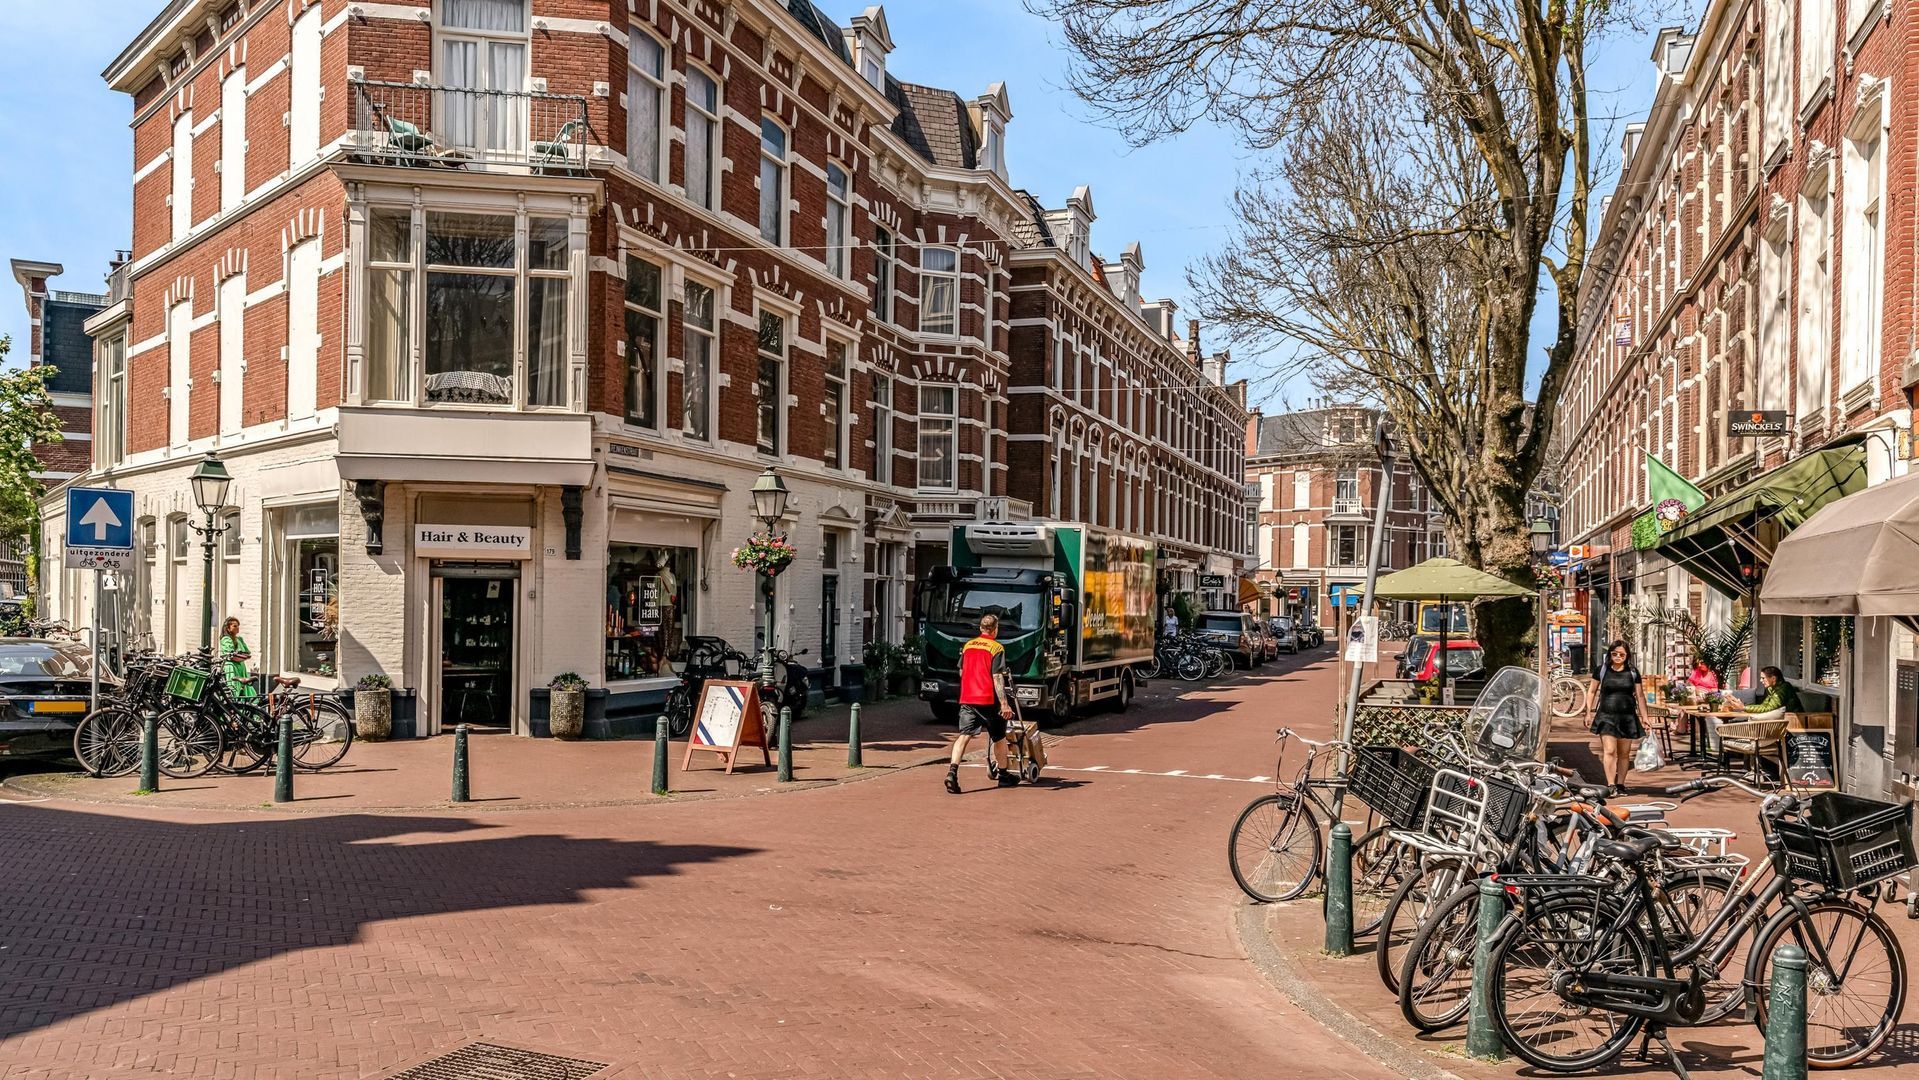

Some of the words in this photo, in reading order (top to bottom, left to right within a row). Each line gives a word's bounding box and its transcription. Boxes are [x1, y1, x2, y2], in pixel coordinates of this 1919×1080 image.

[421, 531, 453, 542] Hair
[457, 532, 469, 543] &
[474, 532, 525, 547] Beauty
[70, 549, 130, 558] uitgezonderd
